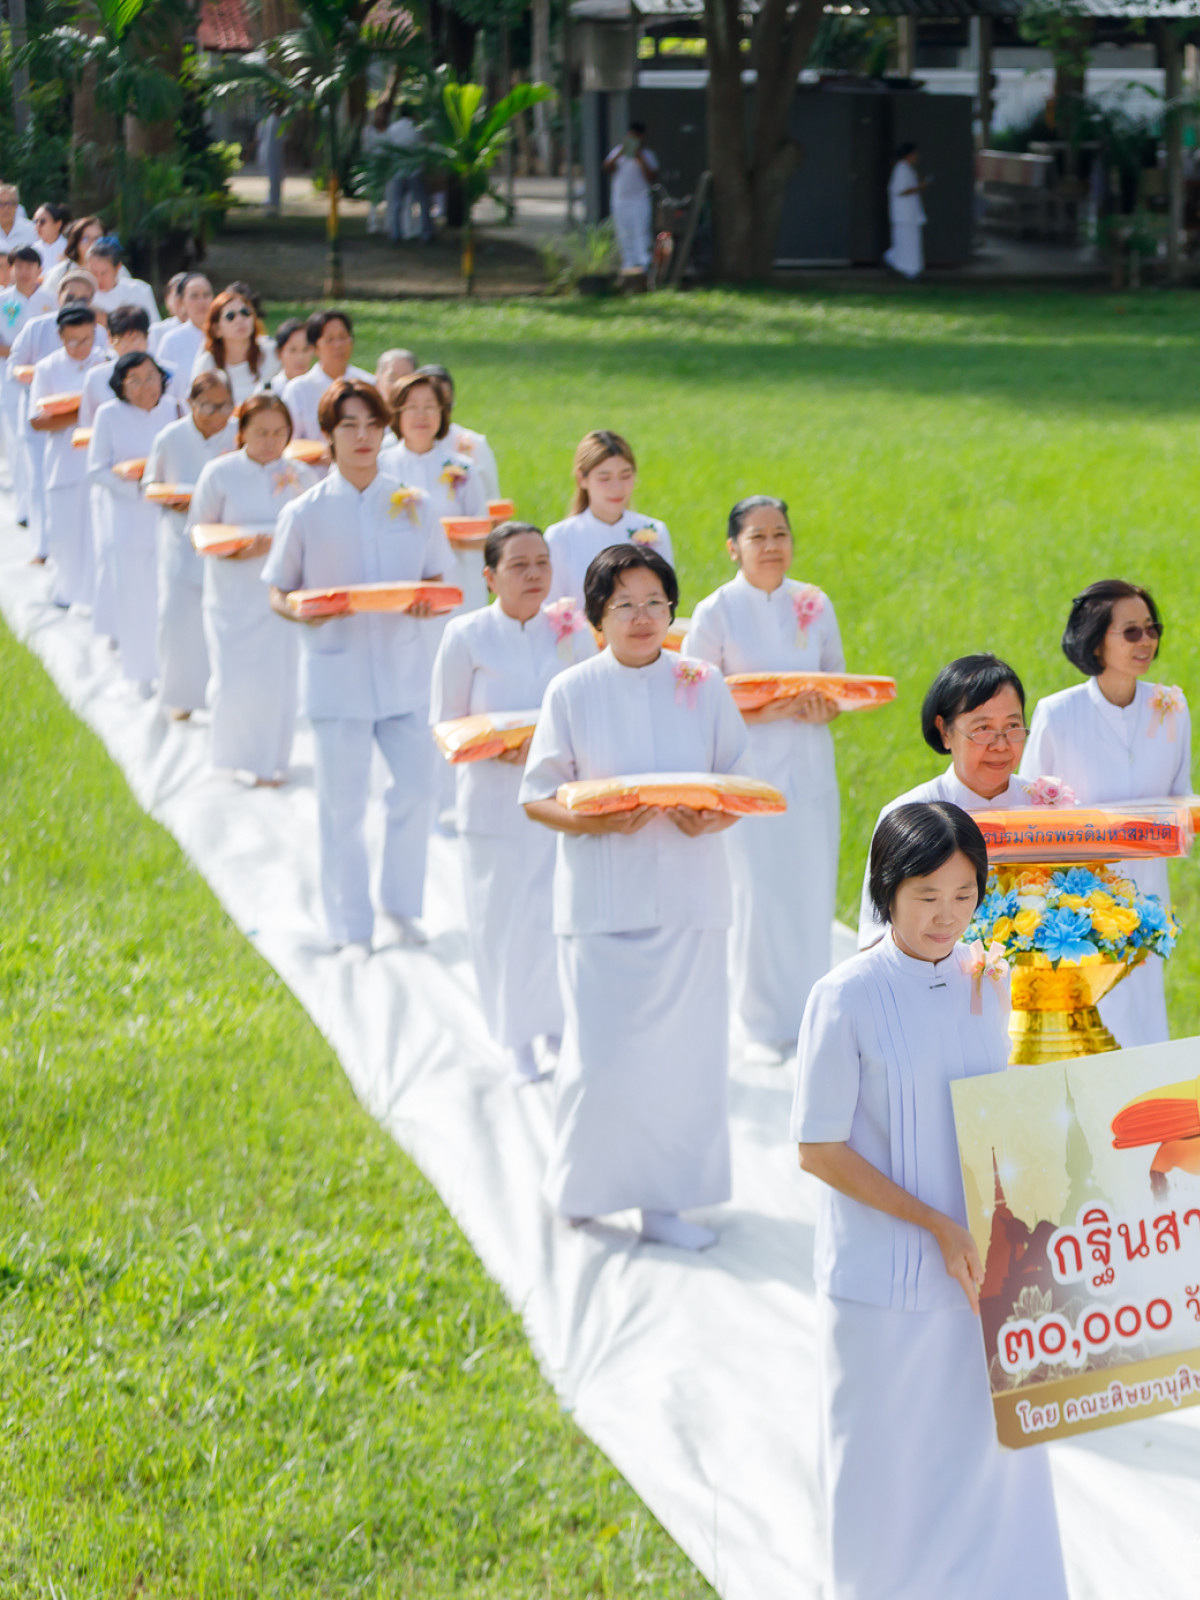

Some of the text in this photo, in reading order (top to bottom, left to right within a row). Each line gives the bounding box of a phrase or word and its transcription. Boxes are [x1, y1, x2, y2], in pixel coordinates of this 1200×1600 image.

[980, 820, 1172, 845] รบรมจักรพรรดิมหาสมบัติ
[1004, 1298, 1173, 1365] ๓๐,๐๐๐
[1018, 1403, 1057, 1431] โดย
